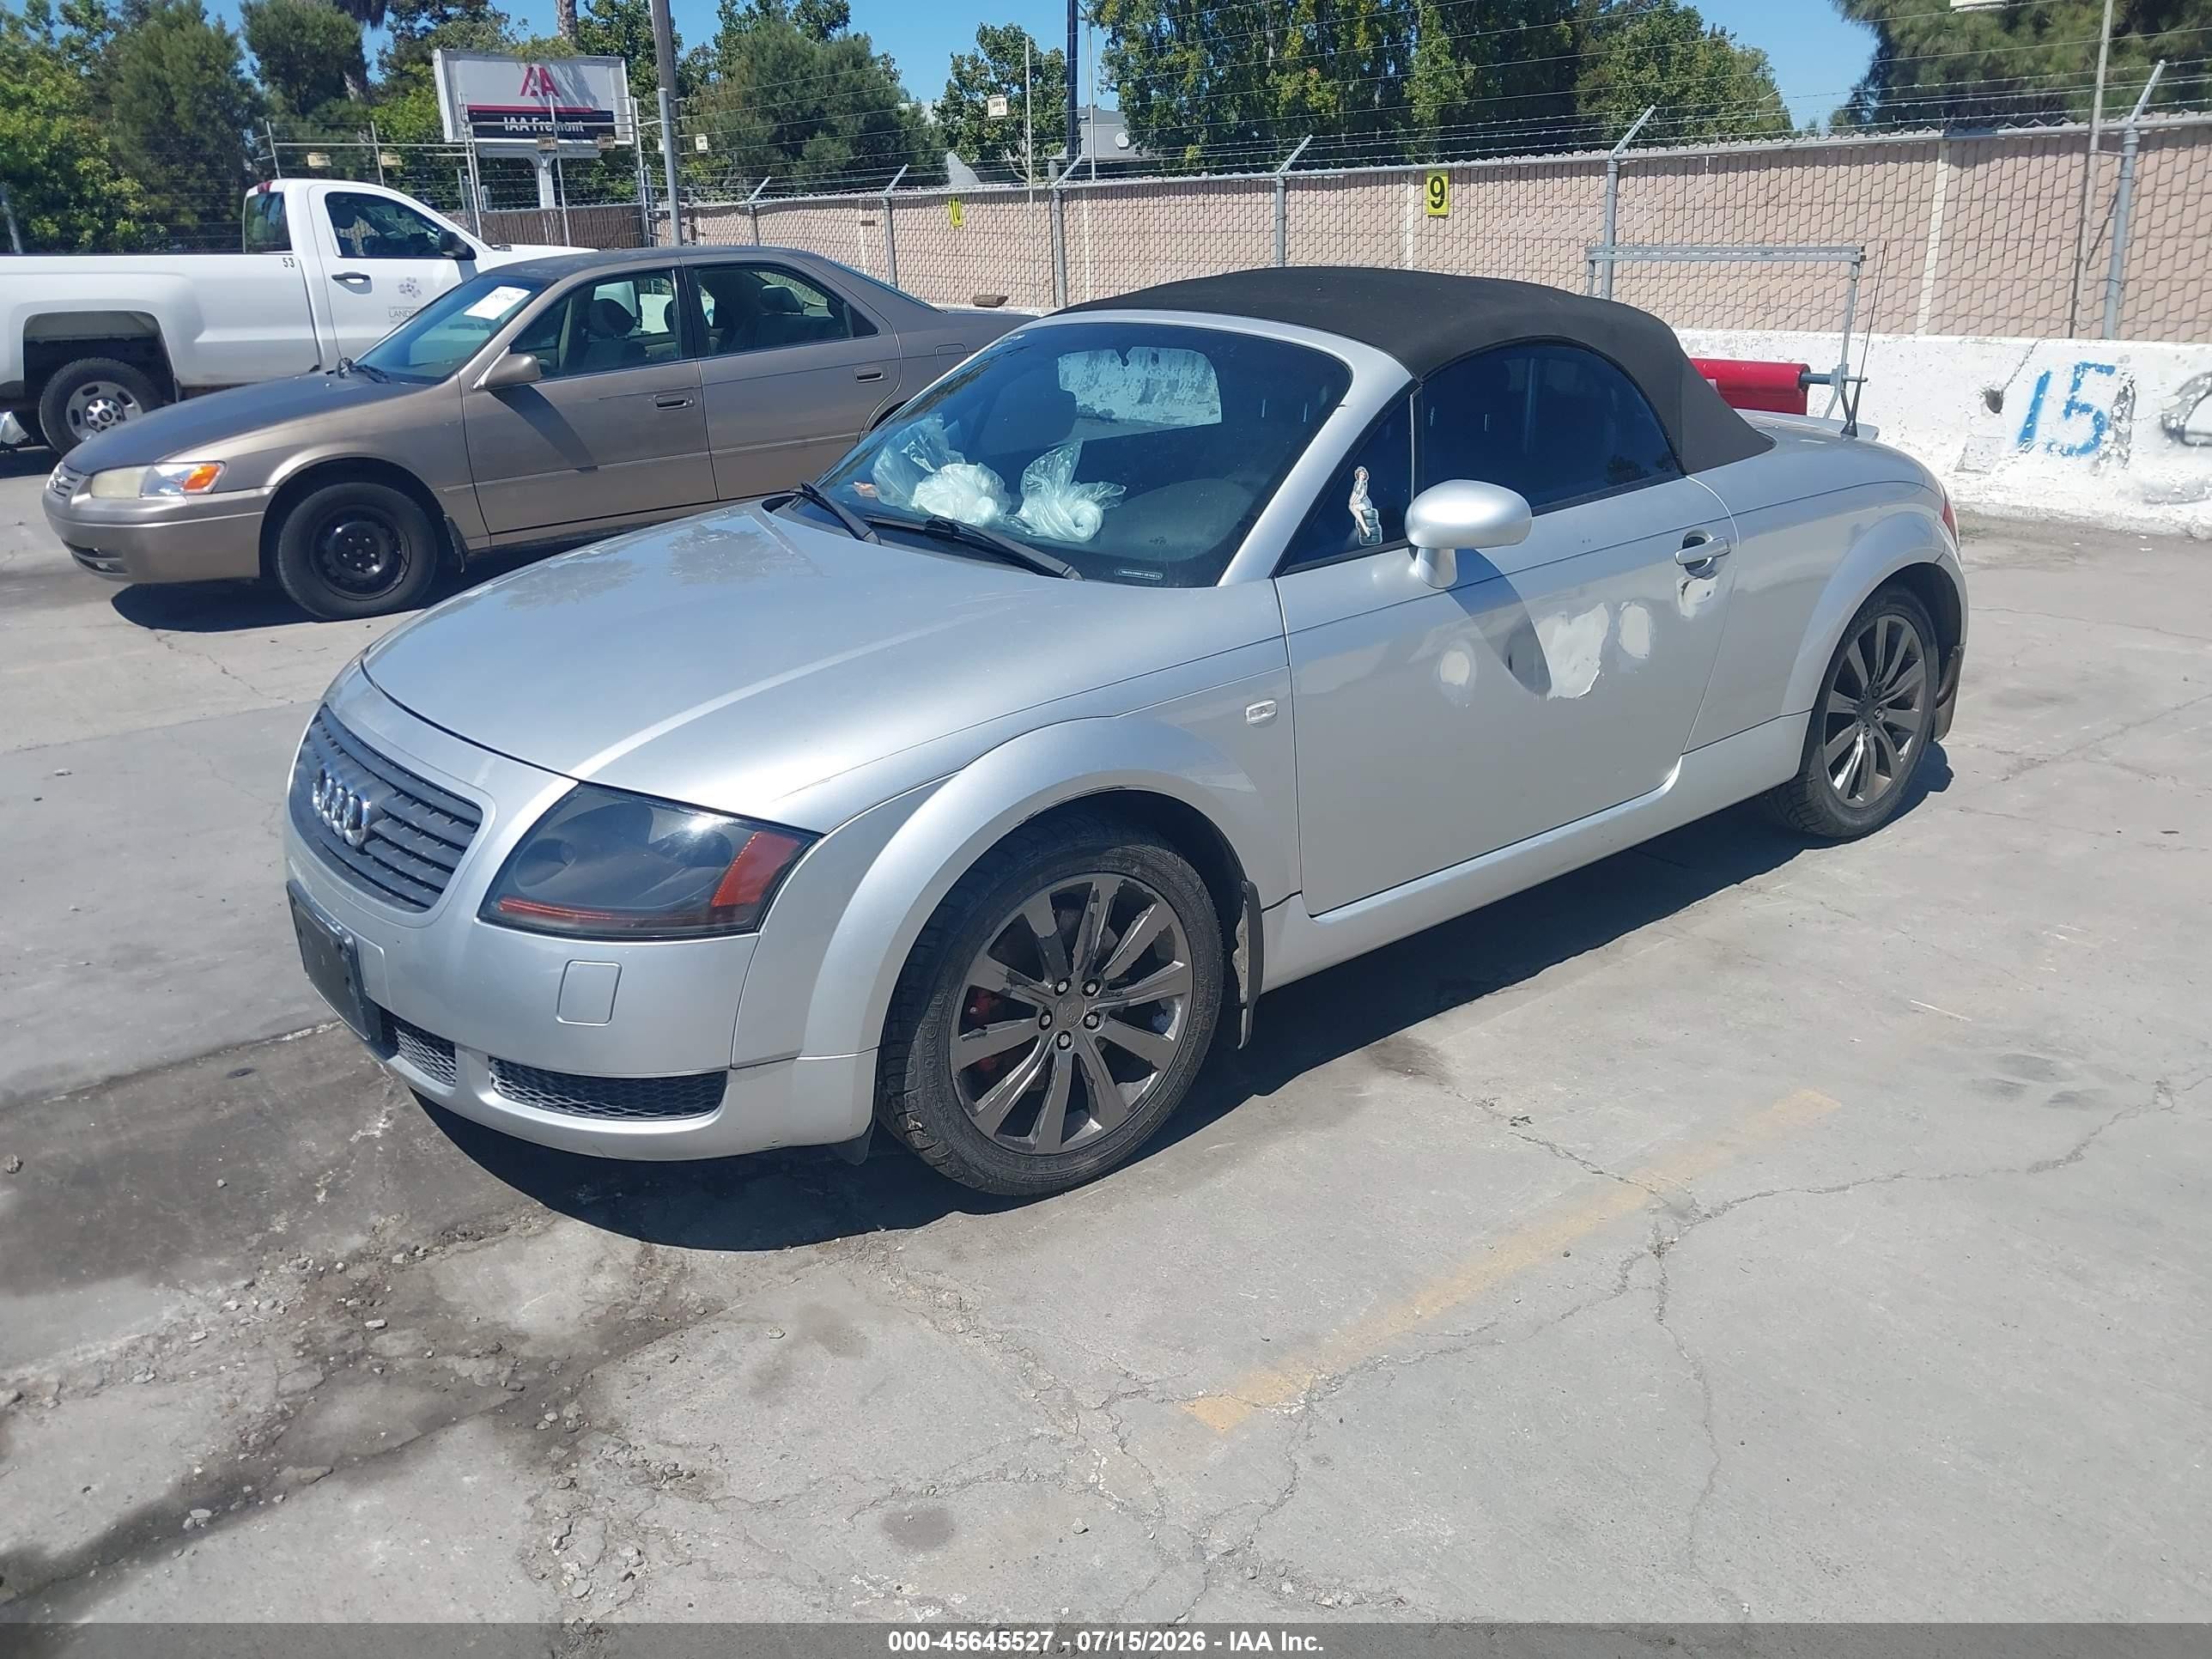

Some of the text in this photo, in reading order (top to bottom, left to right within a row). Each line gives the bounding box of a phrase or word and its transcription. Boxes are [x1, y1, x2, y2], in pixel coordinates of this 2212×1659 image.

[503, 117, 531, 131] IAA
[1430, 175, 1445, 209] 9
[950, 197, 961, 222] 10
[283, 257, 295, 268] 53
[2016, 361, 2117, 459] 15
